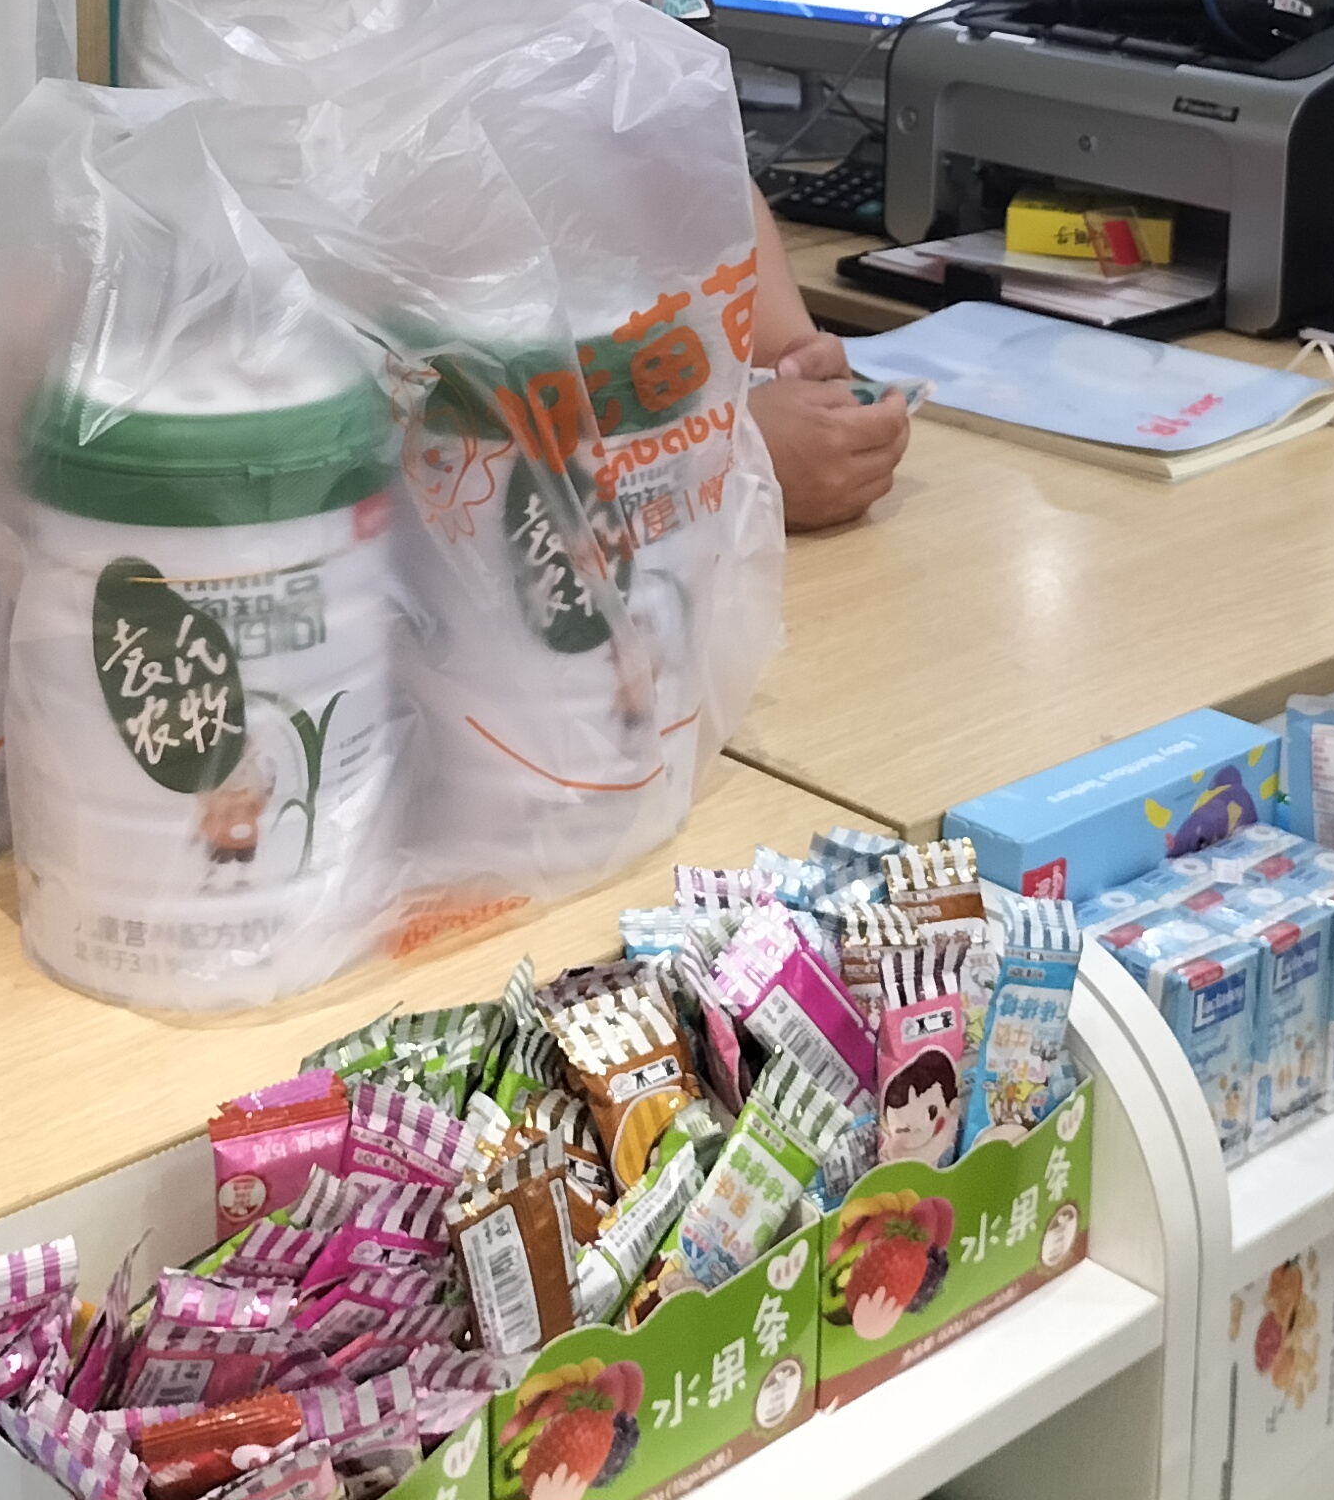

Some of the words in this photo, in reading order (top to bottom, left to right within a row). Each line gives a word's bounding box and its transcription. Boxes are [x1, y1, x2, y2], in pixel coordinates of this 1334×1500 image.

[125, 682, 243, 765] 农牧
[916, 1009, 954, 1034] 不二家
[631, 1058, 678, 1090] 不二家
[959, 1144, 1071, 1264] 水果条
[651, 1293, 790, 1429] 水果条
